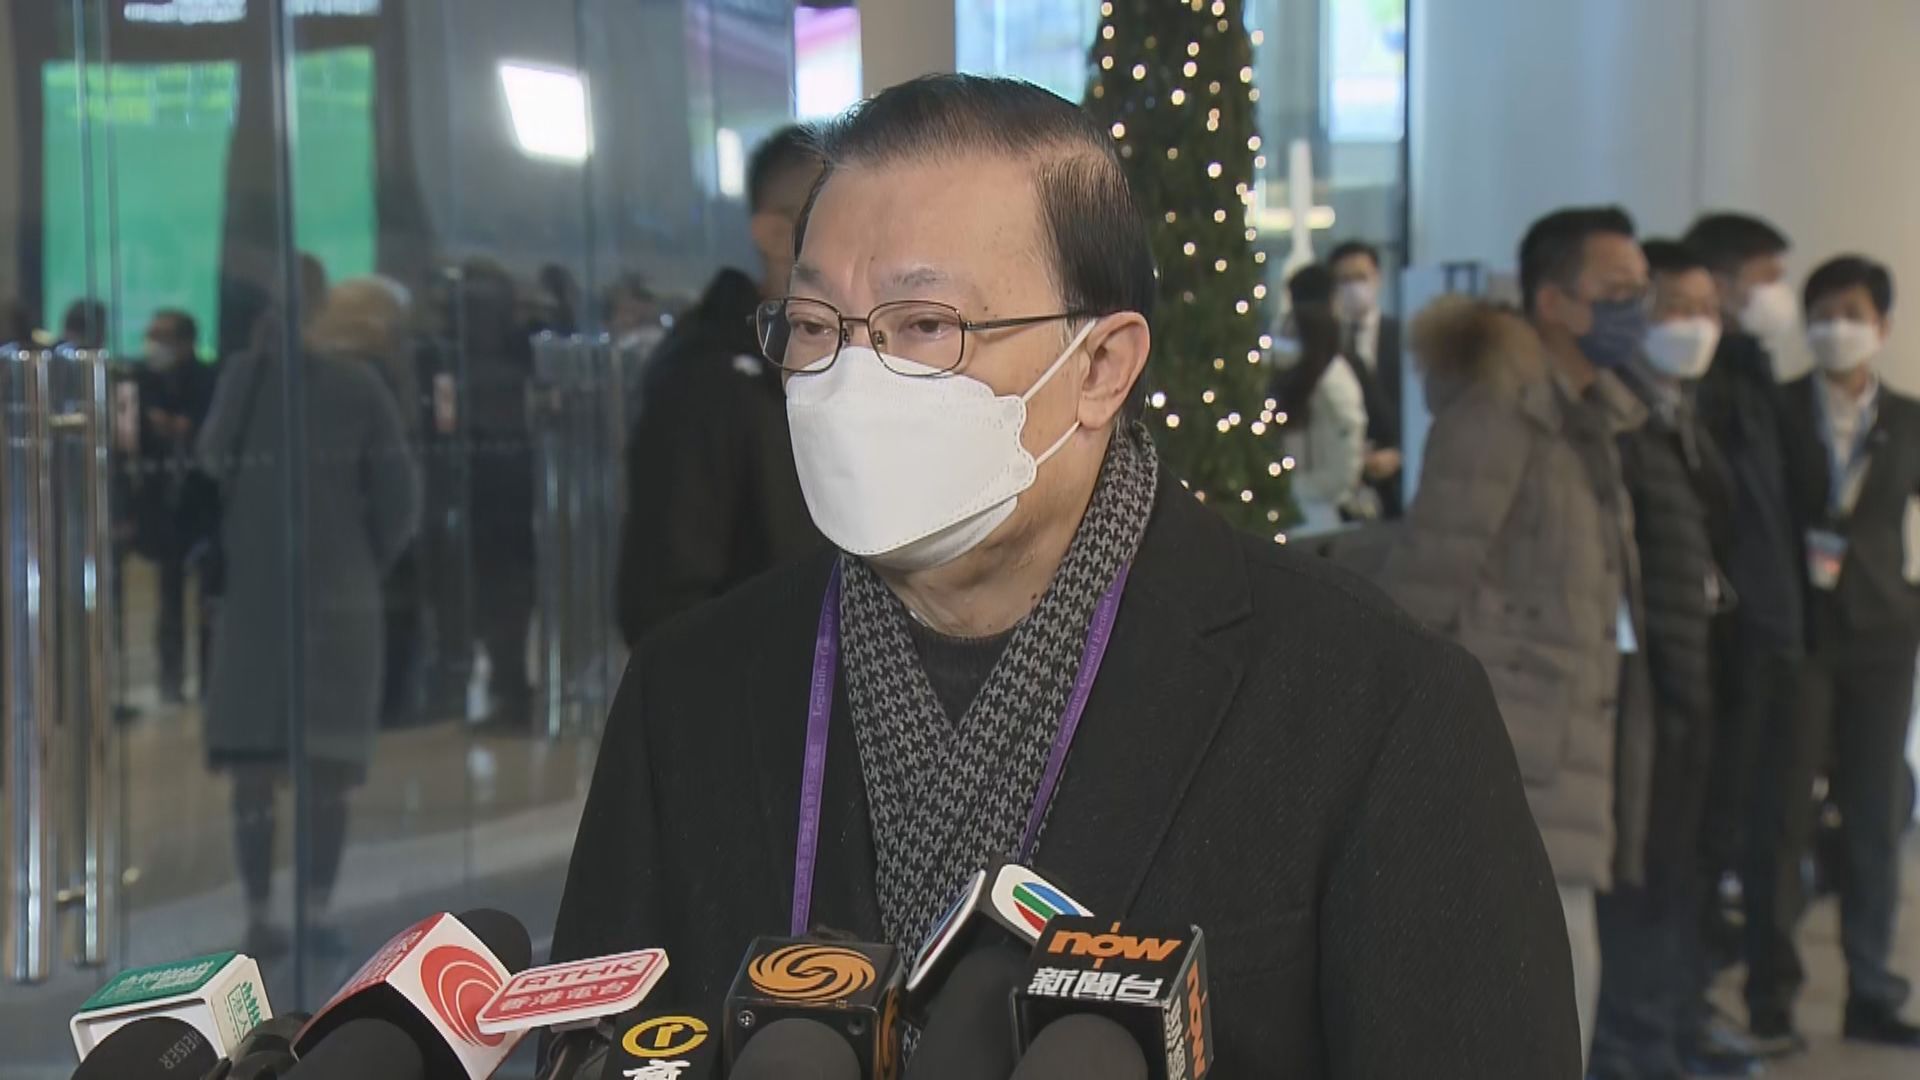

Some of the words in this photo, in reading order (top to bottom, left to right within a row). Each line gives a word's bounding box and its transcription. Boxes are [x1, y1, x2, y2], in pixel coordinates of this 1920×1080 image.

[1048, 922, 1182, 968] now
[518, 959, 642, 990] RTHK
[1027, 966, 1163, 1001] 新聞台
